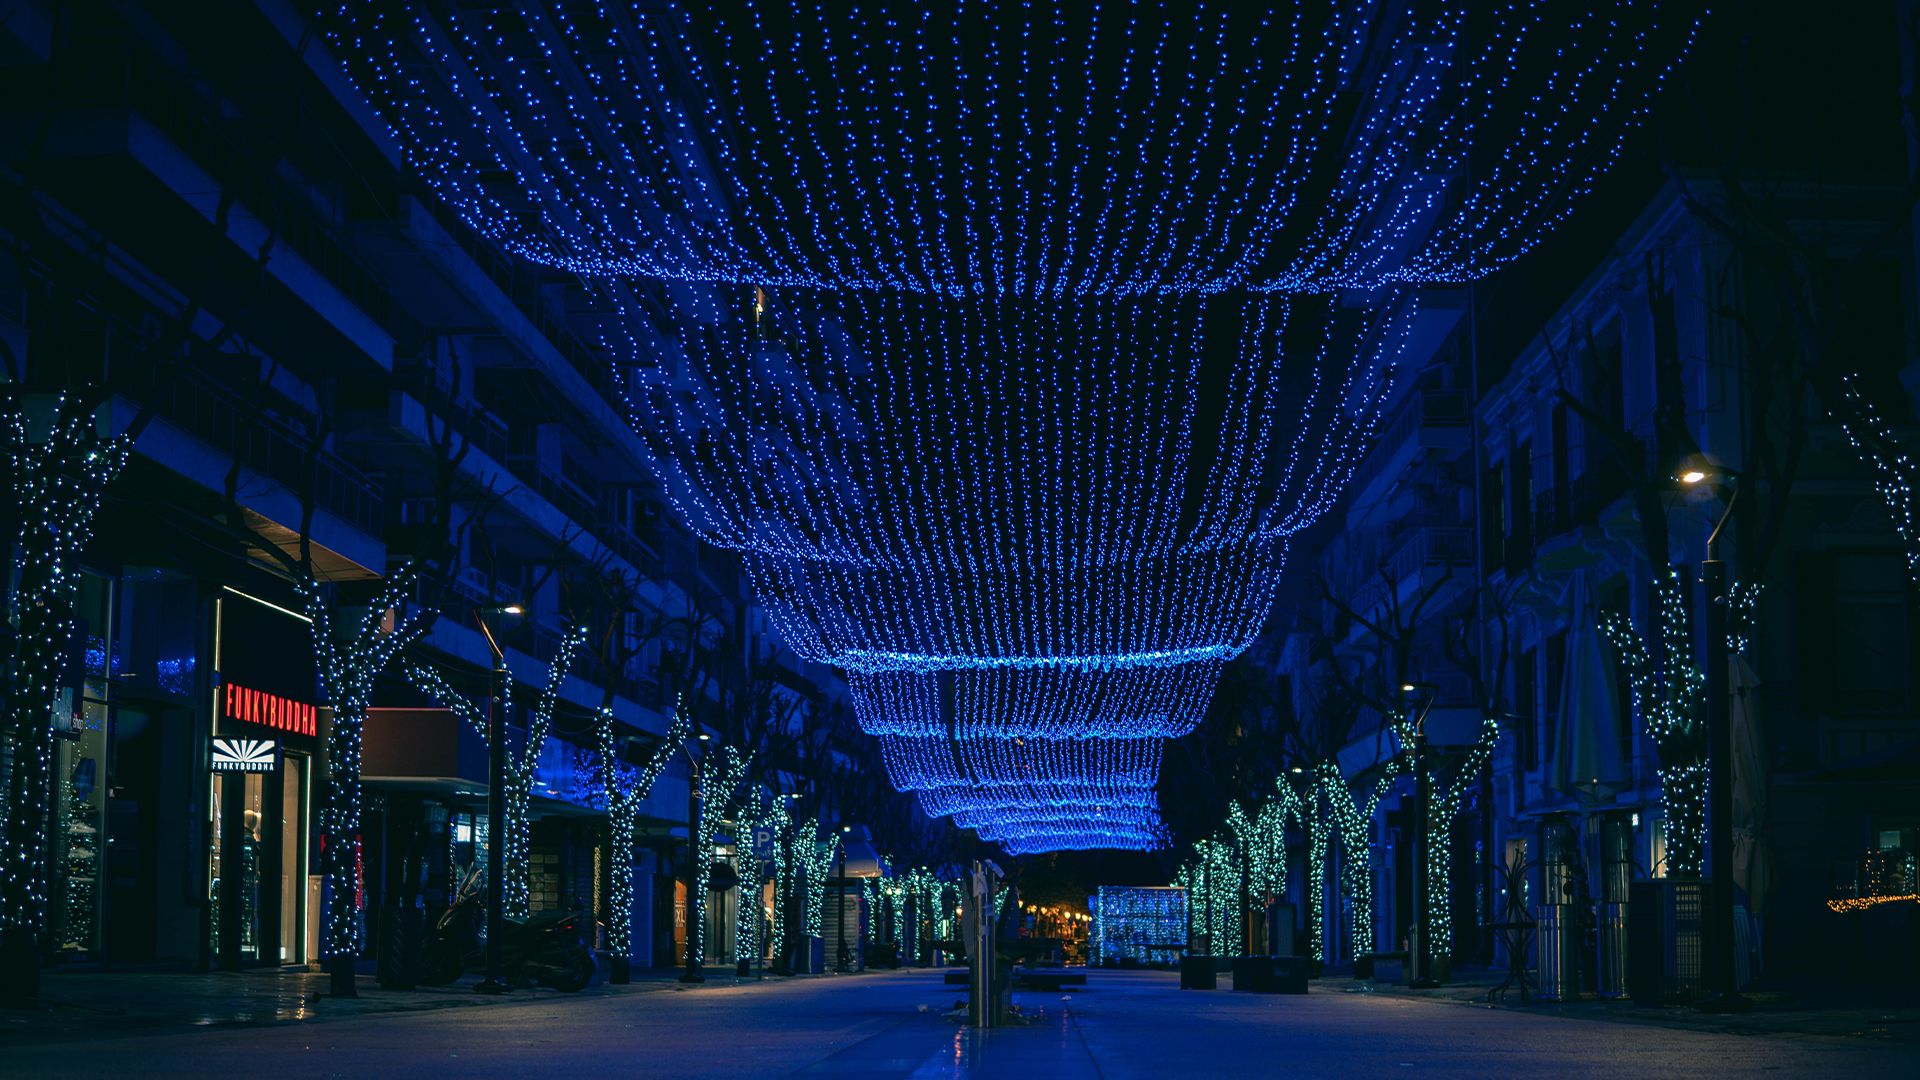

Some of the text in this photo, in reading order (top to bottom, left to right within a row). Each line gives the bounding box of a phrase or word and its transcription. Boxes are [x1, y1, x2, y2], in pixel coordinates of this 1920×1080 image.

[226, 682, 316, 737] FUNKYBUDDHA
[212, 762, 274, 771] FUNKYBUDDHA
[757, 831, 770, 848] P
